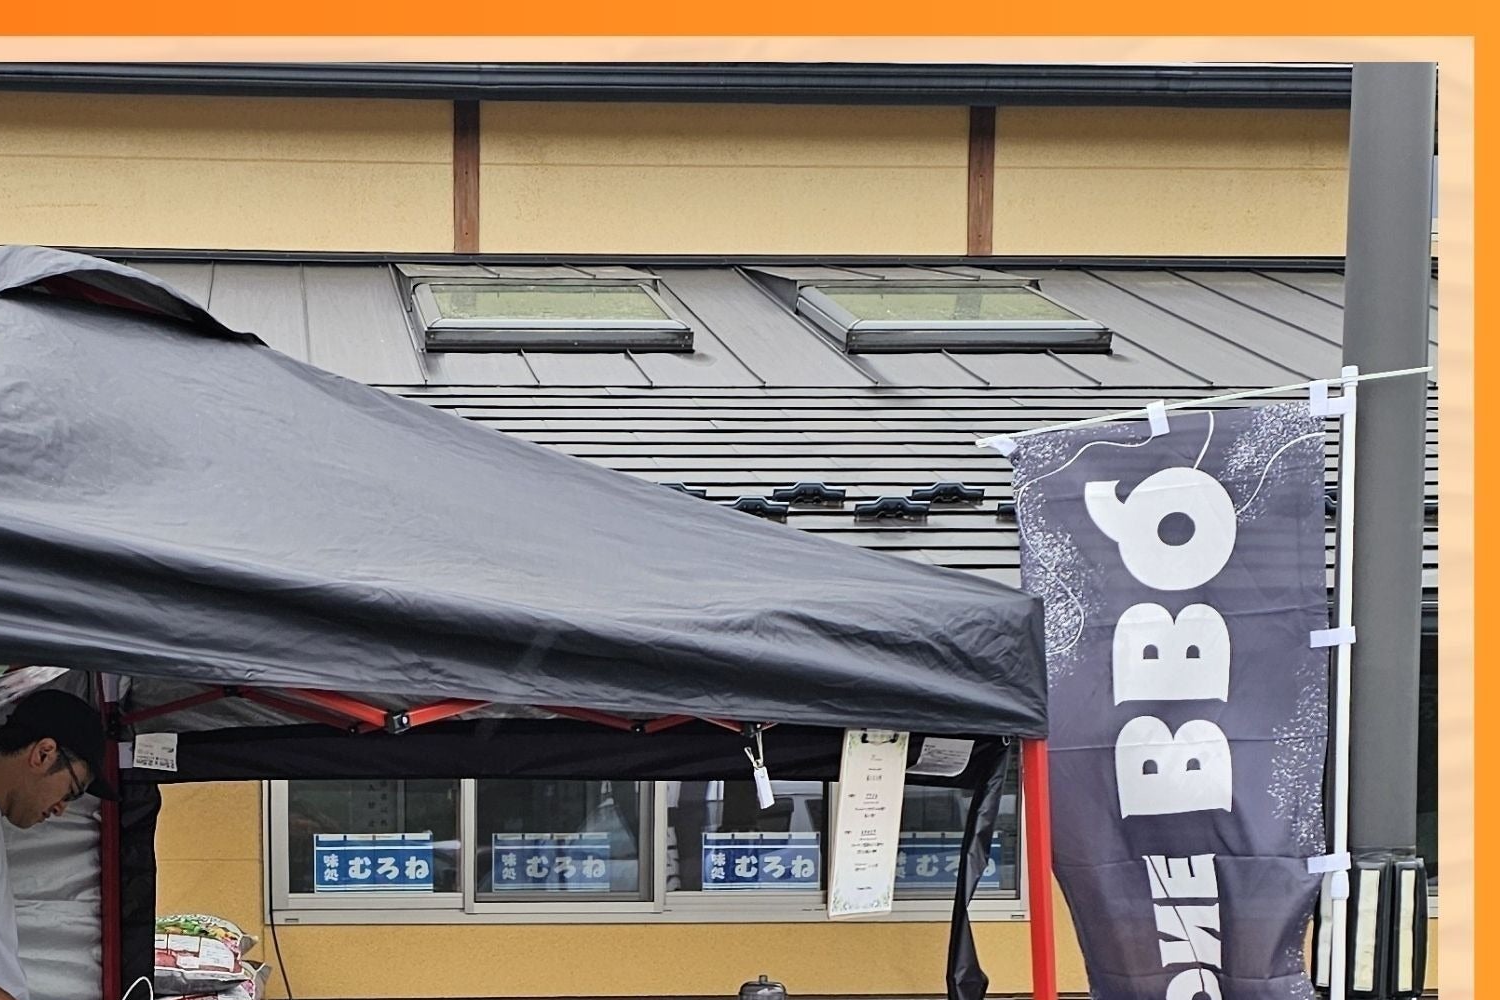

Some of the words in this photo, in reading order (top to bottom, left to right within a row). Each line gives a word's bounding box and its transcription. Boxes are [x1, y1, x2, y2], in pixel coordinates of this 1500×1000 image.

[1085, 466, 1237, 820] BBQ
[349, 855, 429, 880] むろね
[526, 855, 606, 879] むろね
[735, 855, 815, 879] むろね
